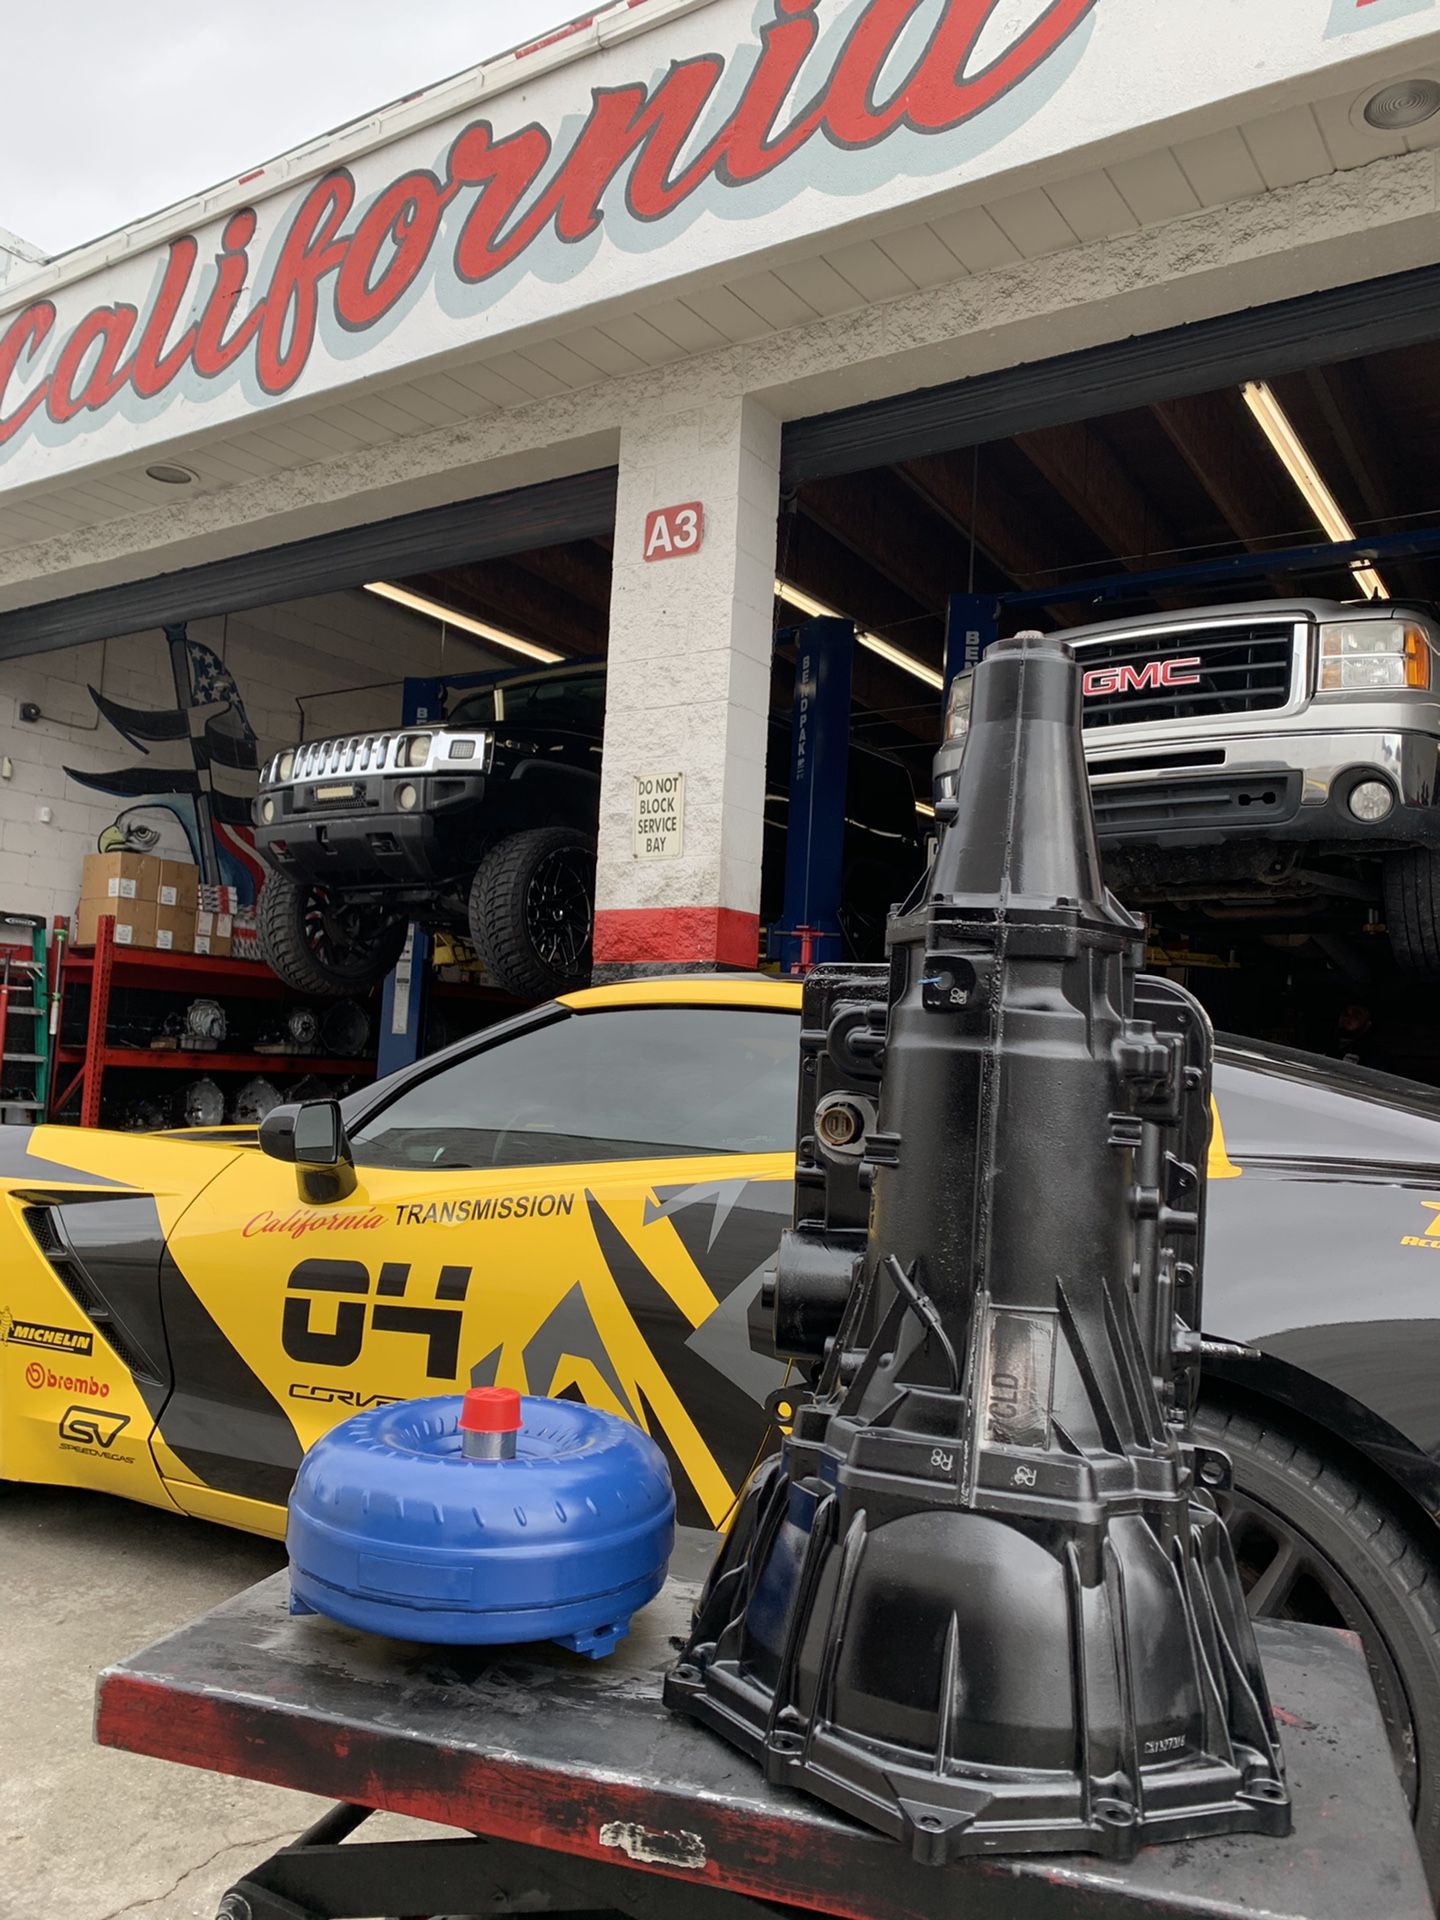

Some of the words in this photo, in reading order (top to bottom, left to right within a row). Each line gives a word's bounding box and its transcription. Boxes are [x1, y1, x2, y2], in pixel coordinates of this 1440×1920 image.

[0, 0, 1098, 446] California
[646, 509, 698, 556] A3
[1083, 656, 1200, 696] GMC
[638, 780, 653, 796] DO
[655, 777, 679, 794] NOT
[640, 797, 675, 815] BLOCK
[638, 816, 677, 834] SERVICE
[646, 836, 666, 853] BAY
[242, 1206, 389, 1240] California
[395, 1192, 575, 1226] TRANSMISSION
[281, 1257, 473, 1381] 04
[13, 1325, 90, 1349] MICHELIN
[47, 1368, 110, 1398] brembo
[58, 1442, 135, 1464] SPEEDVEGAS
